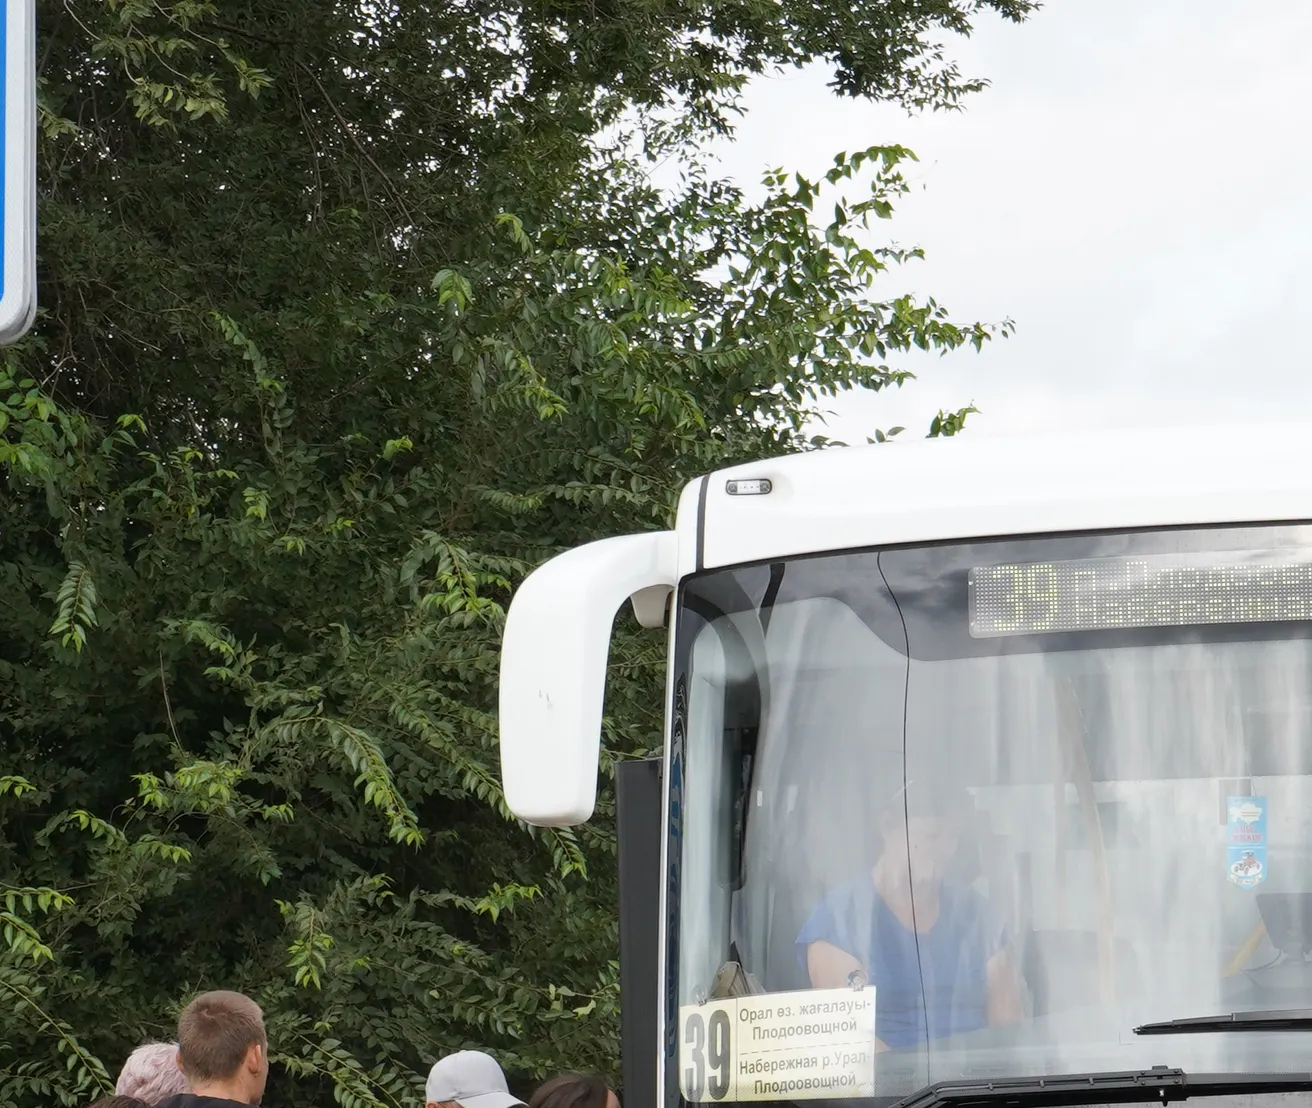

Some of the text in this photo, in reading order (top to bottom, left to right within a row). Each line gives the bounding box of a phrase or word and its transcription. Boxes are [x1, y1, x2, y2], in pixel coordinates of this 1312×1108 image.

[992, 564, 1058, 631] 39
[739, 1007, 773, 1024] Орал
[752, 1017, 857, 1041] Плодоовощной
[684, 1009, 731, 1103] 39
[739, 1055, 818, 1076] Набережная
[754, 1071, 856, 1095] Плодоовощной
